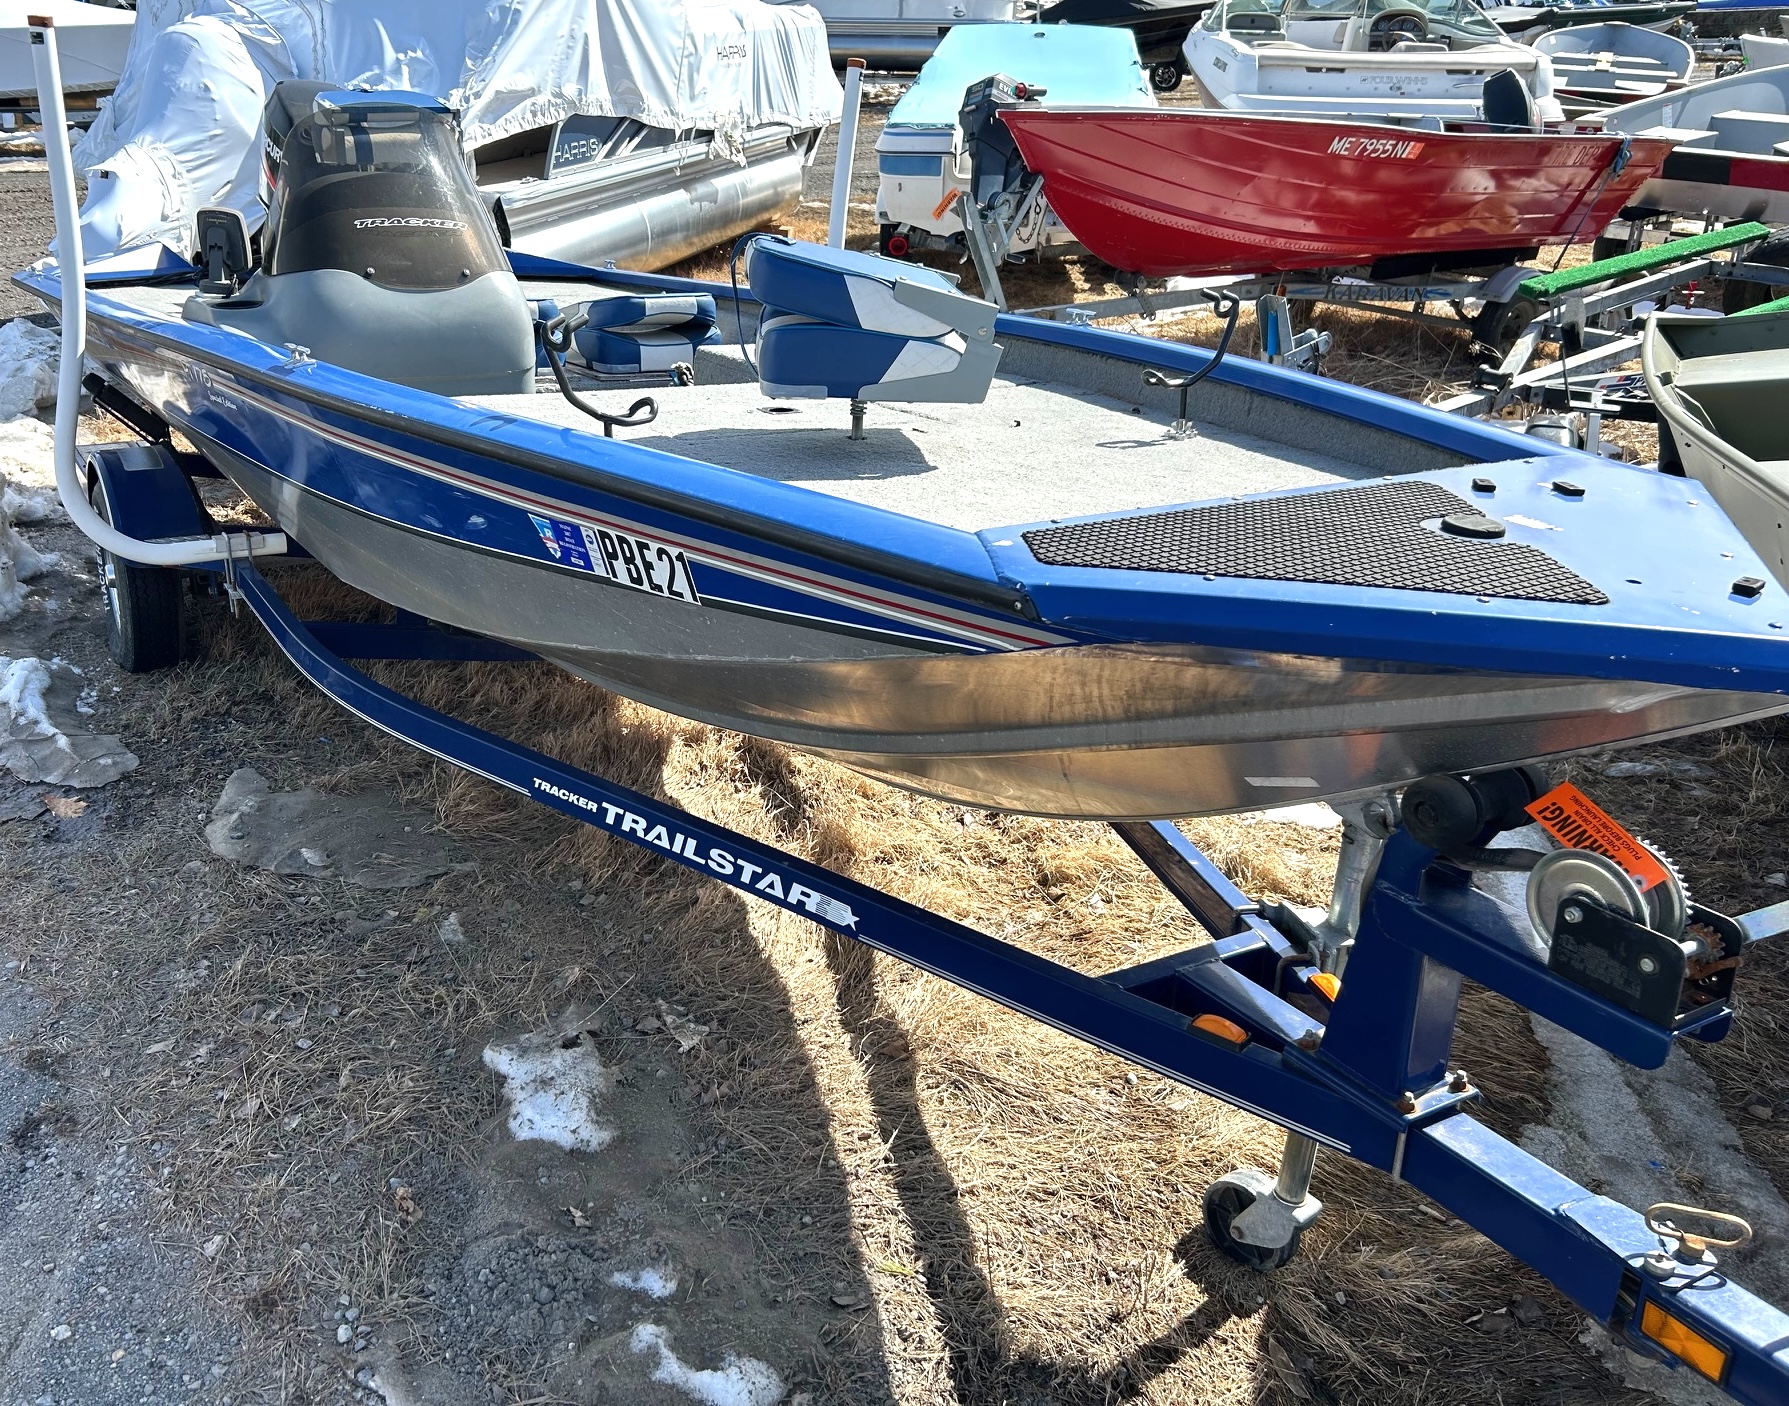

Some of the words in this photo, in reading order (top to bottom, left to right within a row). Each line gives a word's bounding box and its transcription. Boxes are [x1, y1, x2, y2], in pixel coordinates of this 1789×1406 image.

[553, 138, 599, 163] HARRIS
[1327, 136, 1356, 155] ME
[354, 217, 468, 230] TRACKER
[1323, 284, 1427, 301] KARAVAN
[596, 528, 700, 604] PBE21
[1569, 794, 1602, 822] LAUNCHING
[1573, 809, 1592, 826] DRAIN
[1590, 824, 1603, 835] ALL
[1599, 820, 1623, 842] BEFORE
[533, 777, 598, 813] TRACKER
[601, 801, 823, 914] TRAILSTAR
[1600, 833, 1621, 852] CHECK
[1620, 840, 1642, 861] PLUGS
